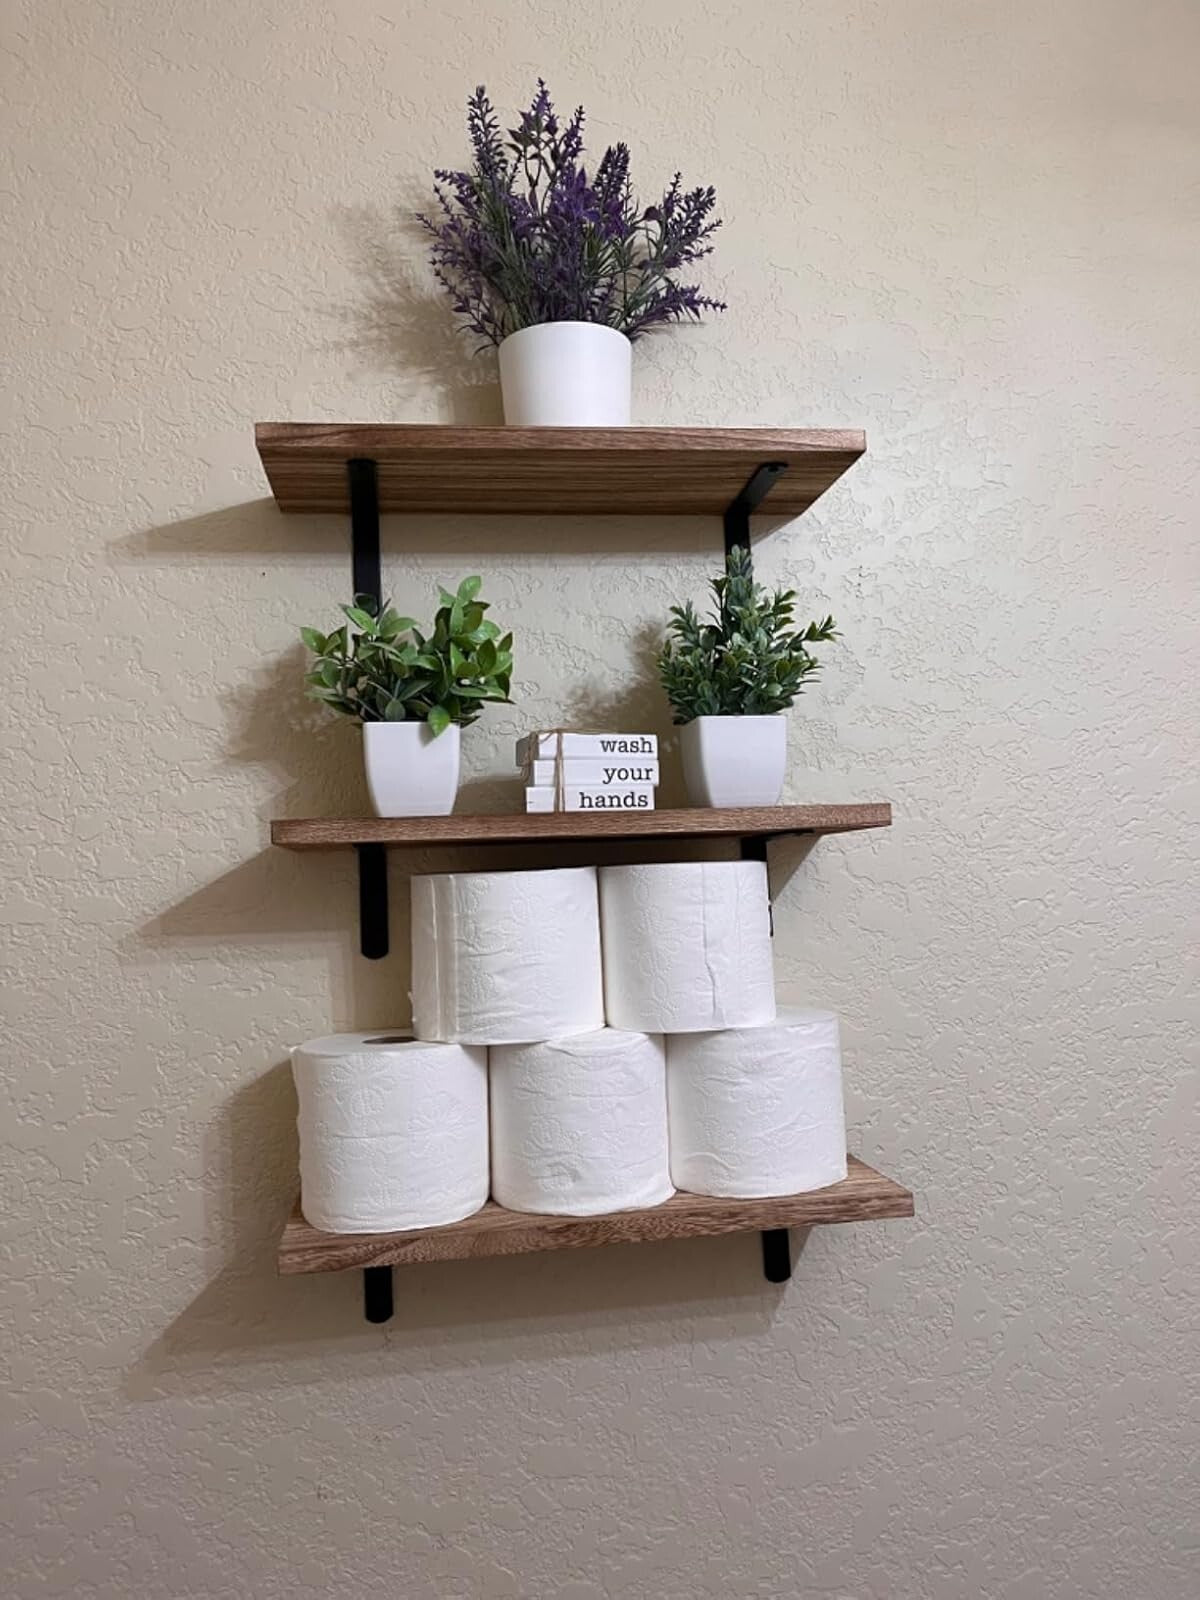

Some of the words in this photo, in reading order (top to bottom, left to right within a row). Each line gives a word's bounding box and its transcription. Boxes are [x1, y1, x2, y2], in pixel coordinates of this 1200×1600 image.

[600, 737, 653, 753] wash
[602, 767, 653, 785] your
[579, 791, 649, 809] hands
